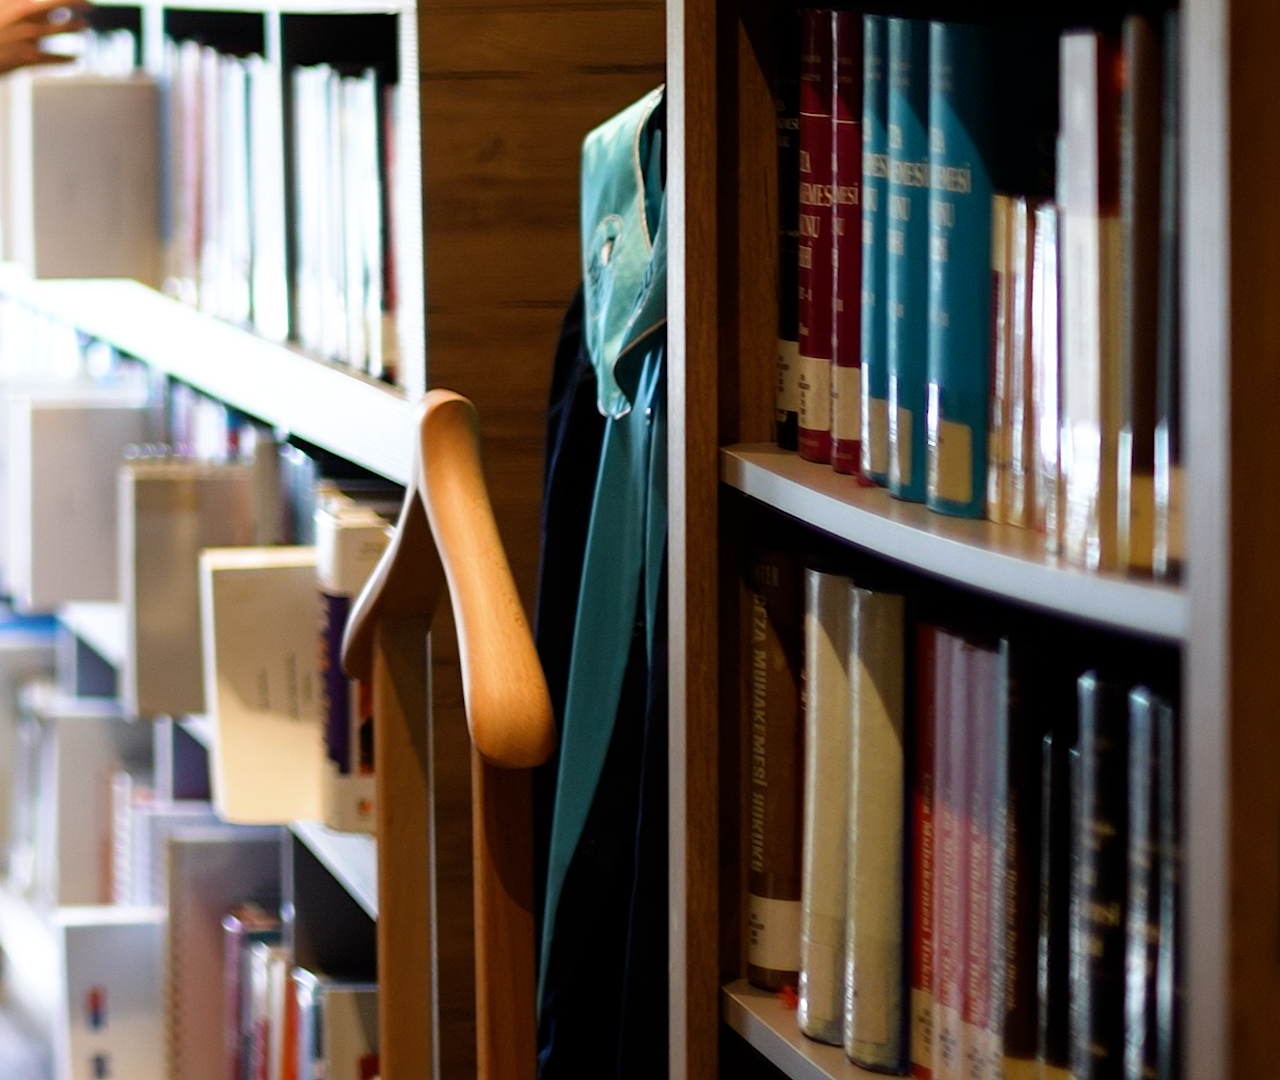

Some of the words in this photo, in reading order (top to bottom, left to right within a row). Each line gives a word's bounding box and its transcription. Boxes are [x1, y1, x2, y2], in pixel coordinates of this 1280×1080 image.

[752, 593, 768, 644] CEZA
[751, 648, 769, 788] MUHAKEMESİ
[750, 792, 766, 874] HUKUKU
